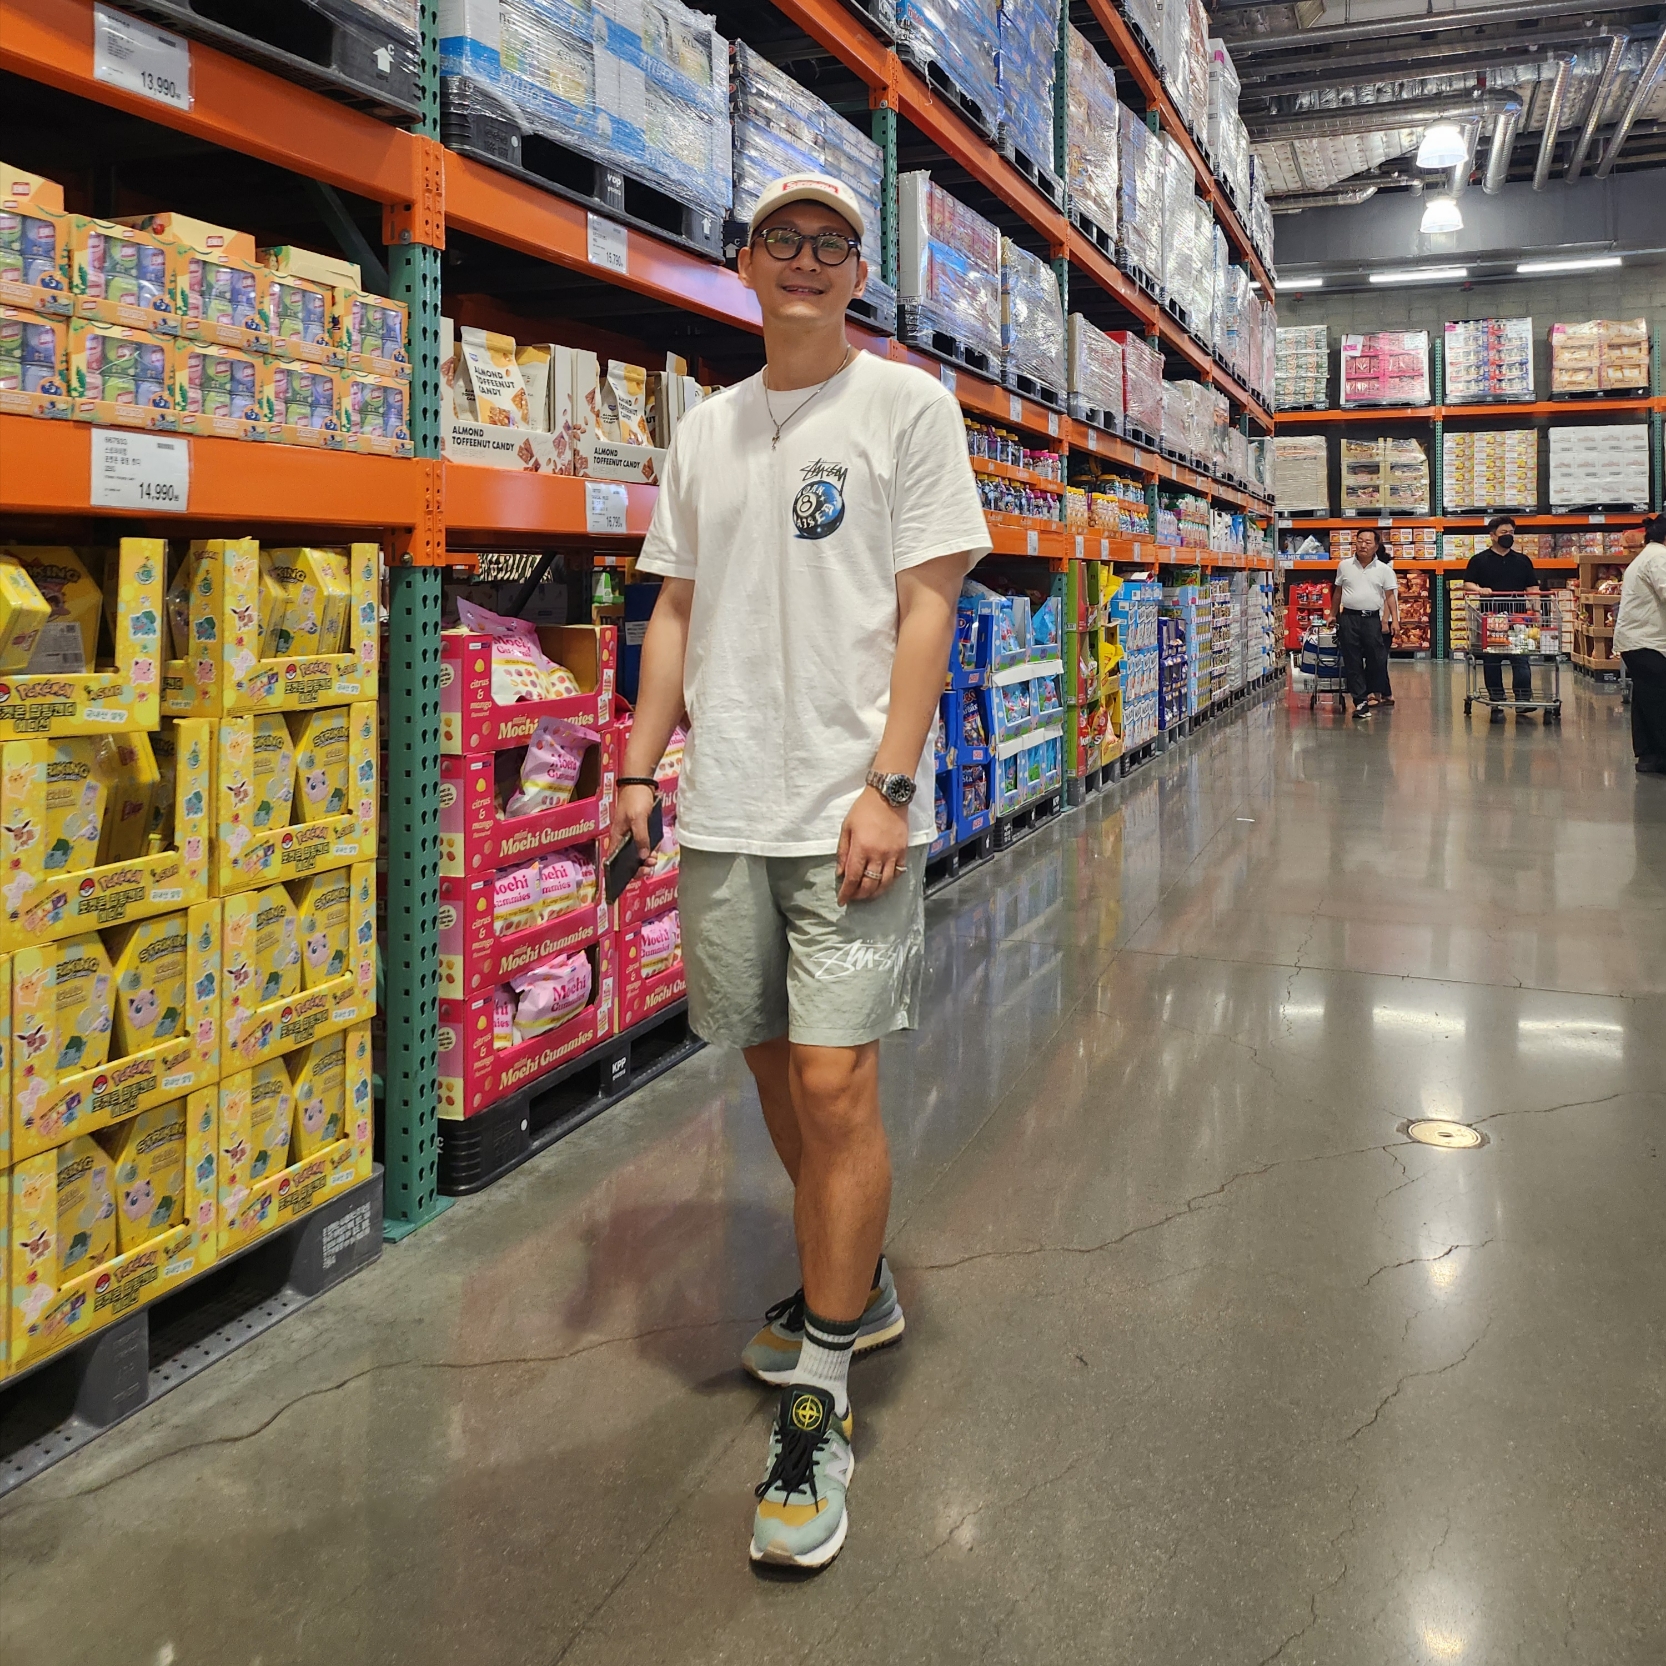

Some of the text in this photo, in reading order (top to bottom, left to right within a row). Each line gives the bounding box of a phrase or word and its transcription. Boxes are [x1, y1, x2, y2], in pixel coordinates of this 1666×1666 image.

[474, 366, 503, 379] ALMOND
[476, 375, 515, 389] TOFFEENUT
[479, 386, 502, 396] CANDY
[452, 426, 484, 437] ALMOND
[452, 436, 515, 451] TOFFEENUT CANDY
[594, 447, 618, 457] ALMOND
[594, 456, 640, 469] TOFFEENUT CANDY
[800, 494, 812, 512] 8
[15, 680, 76, 700] Pokémon
[470, 679, 490, 689] citrus
[477, 688, 484, 700] &
[470, 701, 492, 710] mango
[498, 718, 539, 740] Mochi
[313, 727, 349, 747] STRIKIN
[472, 797, 490, 810] citrus
[478, 809, 486, 819] &
[472, 820, 493, 830] mango
[499, 819, 596, 858] Mochi Gummies
[542, 865, 568, 882] ochi
[645, 887, 674, 912] Mochi
[472, 915, 492, 930] citrus
[478, 928, 486, 938] &
[641, 928, 670, 947] Mochi
[139, 934, 187, 963] STRIKIN
[472, 938, 494, 950] mango
[499, 926, 594, 975] Mochi Gummies
[553, 976, 586, 1002] Mochi
[644, 986, 672, 1012] Mochi
[473, 1033, 492, 1049] citrus
[480, 1045, 486, 1057] &
[474, 1055, 494, 1070] mango
[499, 1029, 594, 1090] Mochi Gummies
[612, 1056, 626, 1074] KPP
